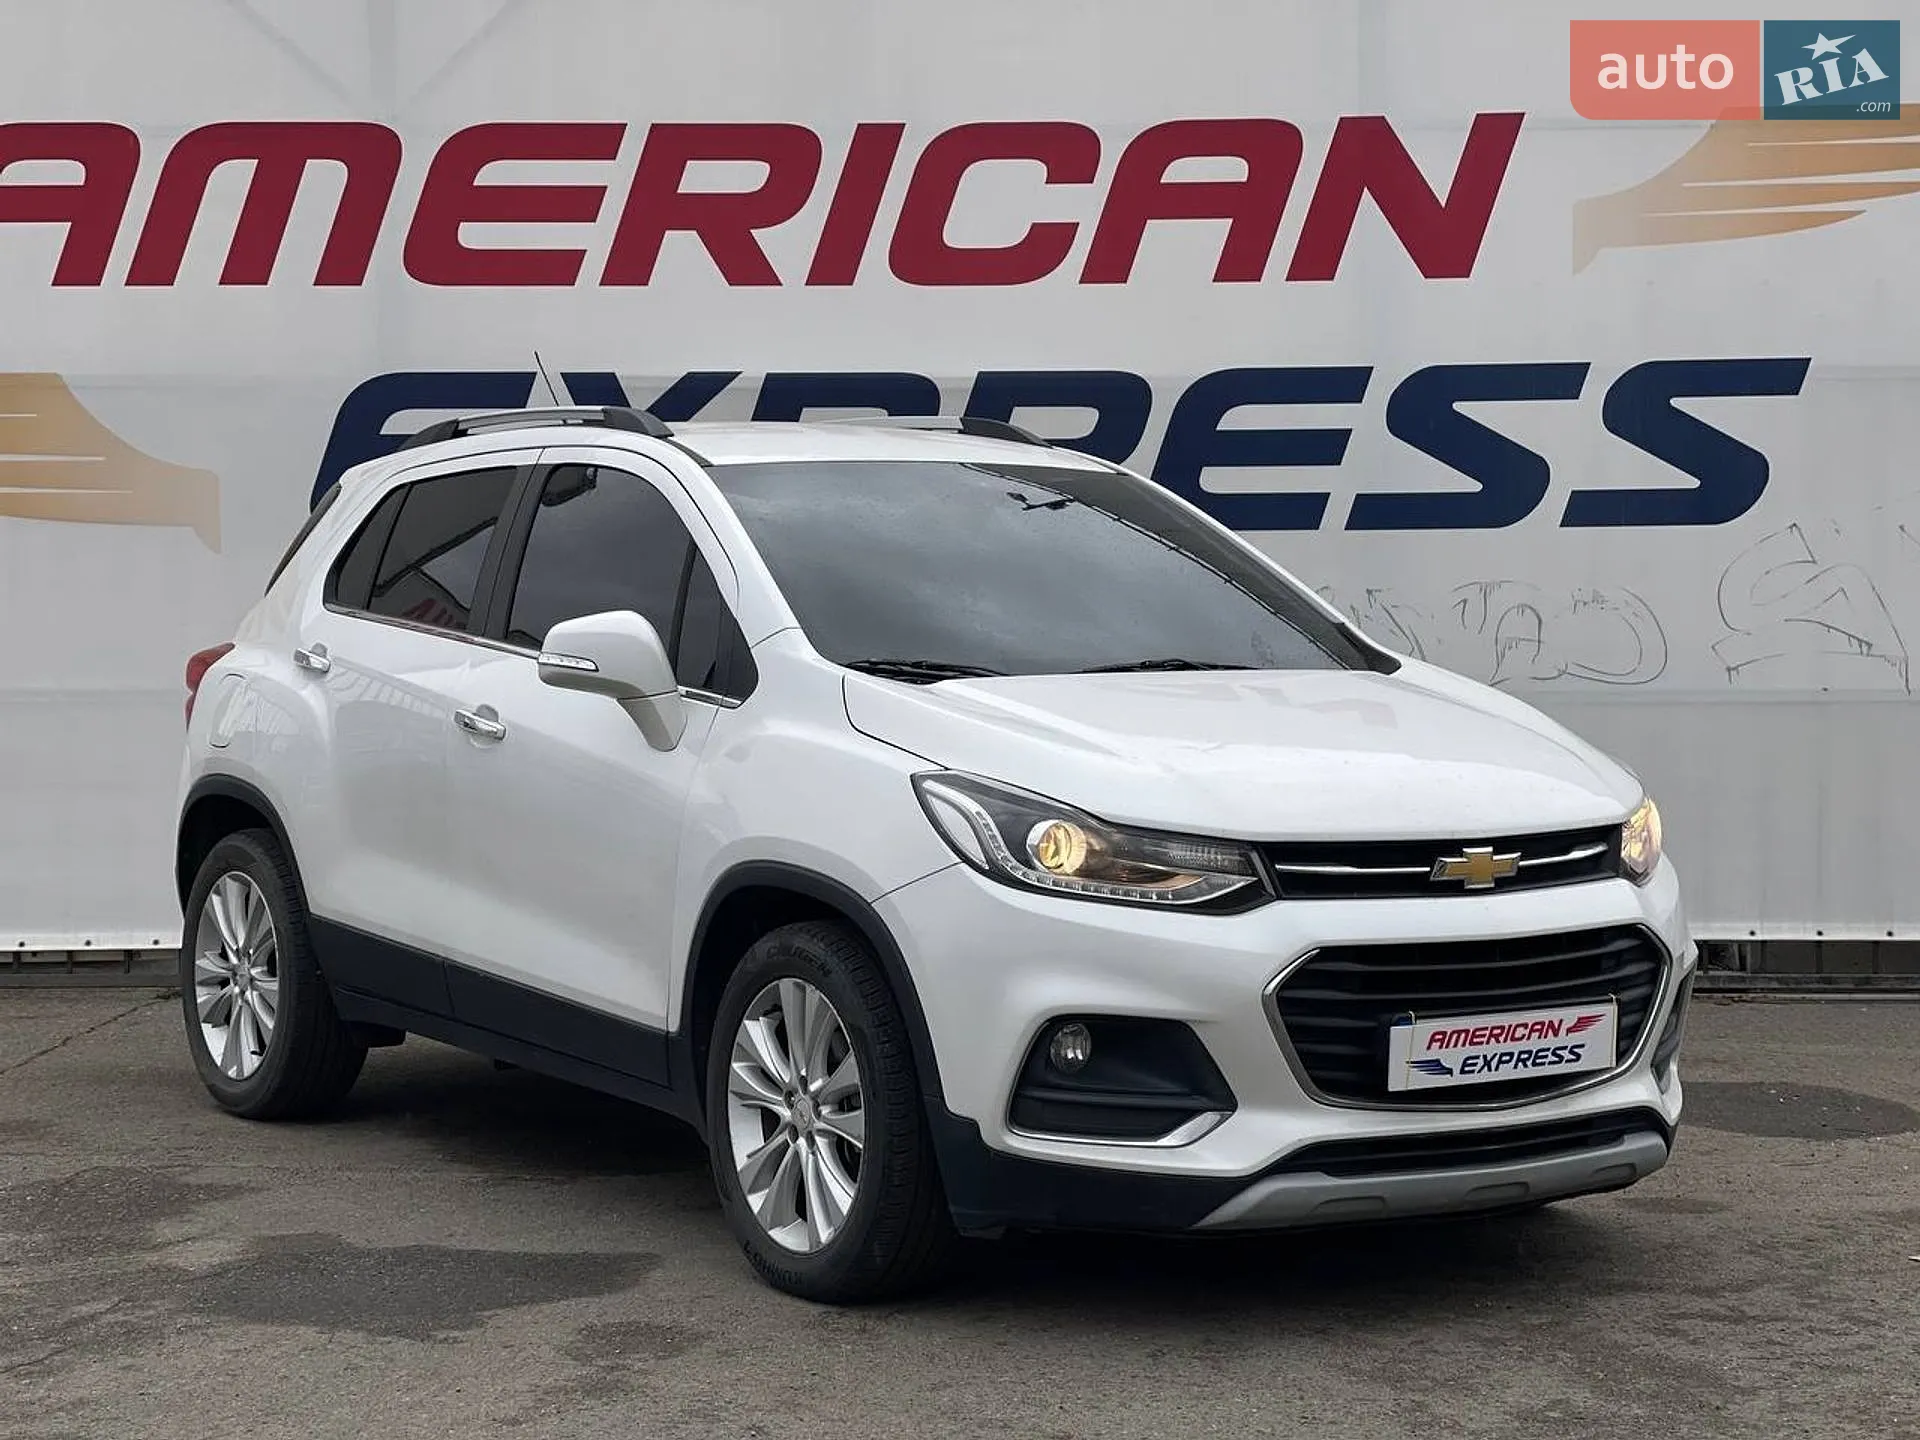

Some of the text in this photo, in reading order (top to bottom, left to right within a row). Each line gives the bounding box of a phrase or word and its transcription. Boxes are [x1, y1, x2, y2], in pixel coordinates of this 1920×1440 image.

[0, 113, 1523, 287] AMERICAN
[311, 358, 1811, 531] RESS
[1426, 1018, 1564, 1051] AMERICAN
[1459, 1043, 1586, 1076] EXPRESS
